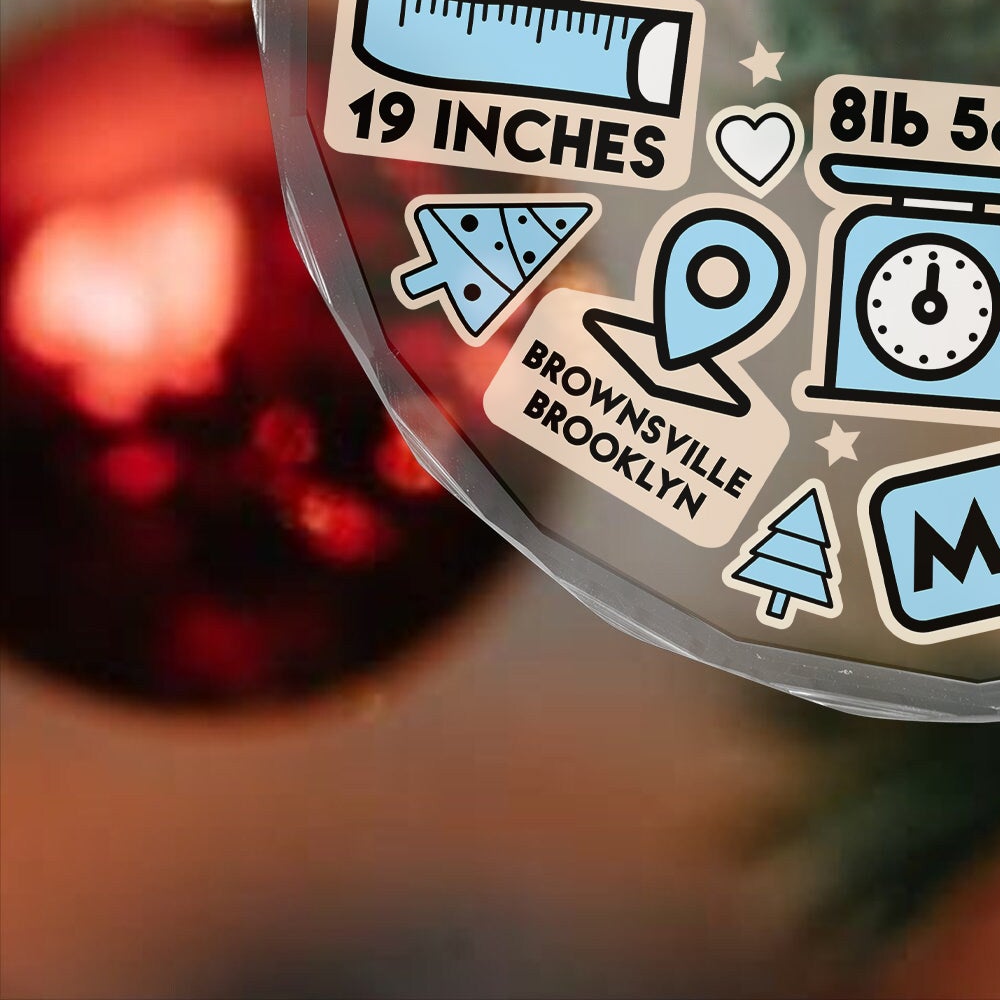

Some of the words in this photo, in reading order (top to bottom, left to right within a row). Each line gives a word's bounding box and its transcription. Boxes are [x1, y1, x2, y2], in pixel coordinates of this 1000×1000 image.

[348, 88, 416, 144] 19
[433, 98, 666, 179] INCHES
[829, 86, 929, 148] 8lb
[521, 339, 753, 499] BROWNSVILLE
[523, 389, 707, 520] BROOKLYN
